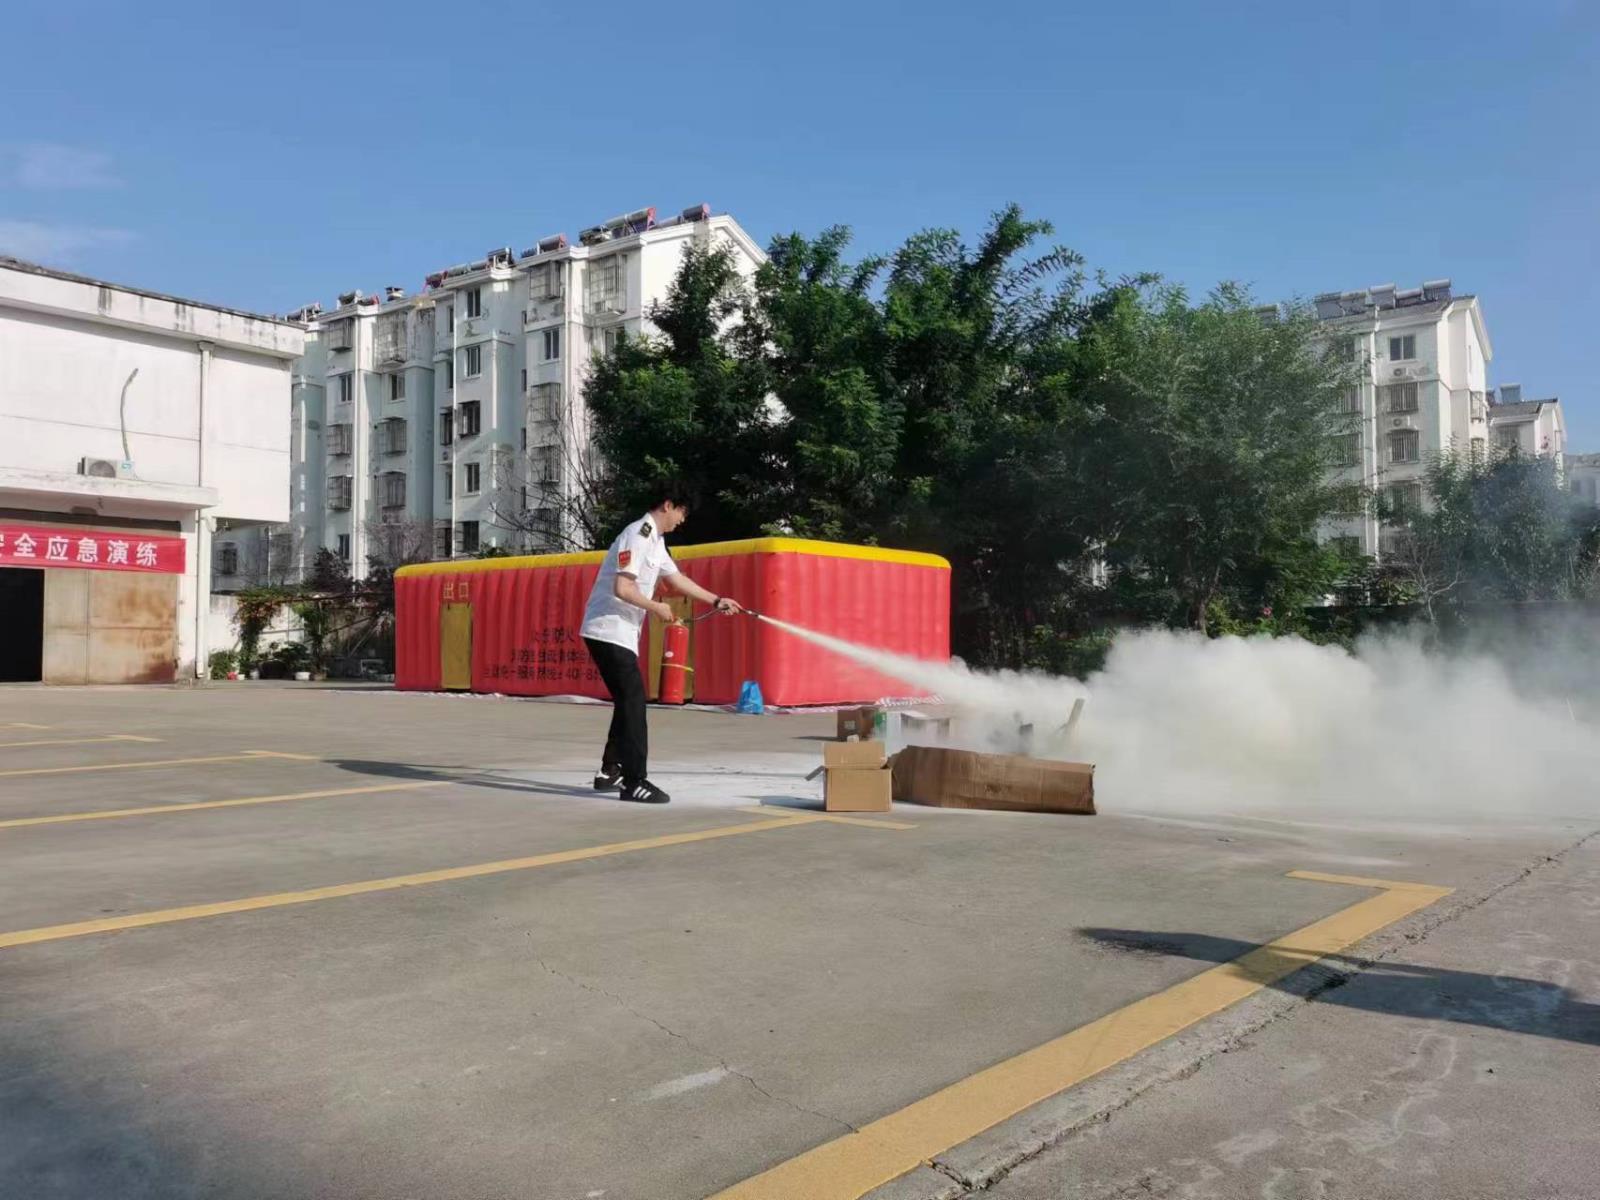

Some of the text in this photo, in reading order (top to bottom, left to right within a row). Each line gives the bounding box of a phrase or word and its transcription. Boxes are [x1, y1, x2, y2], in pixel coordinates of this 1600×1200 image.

[0, 533, 158, 567] 全应急演练
[443, 581, 469, 600] 出口
